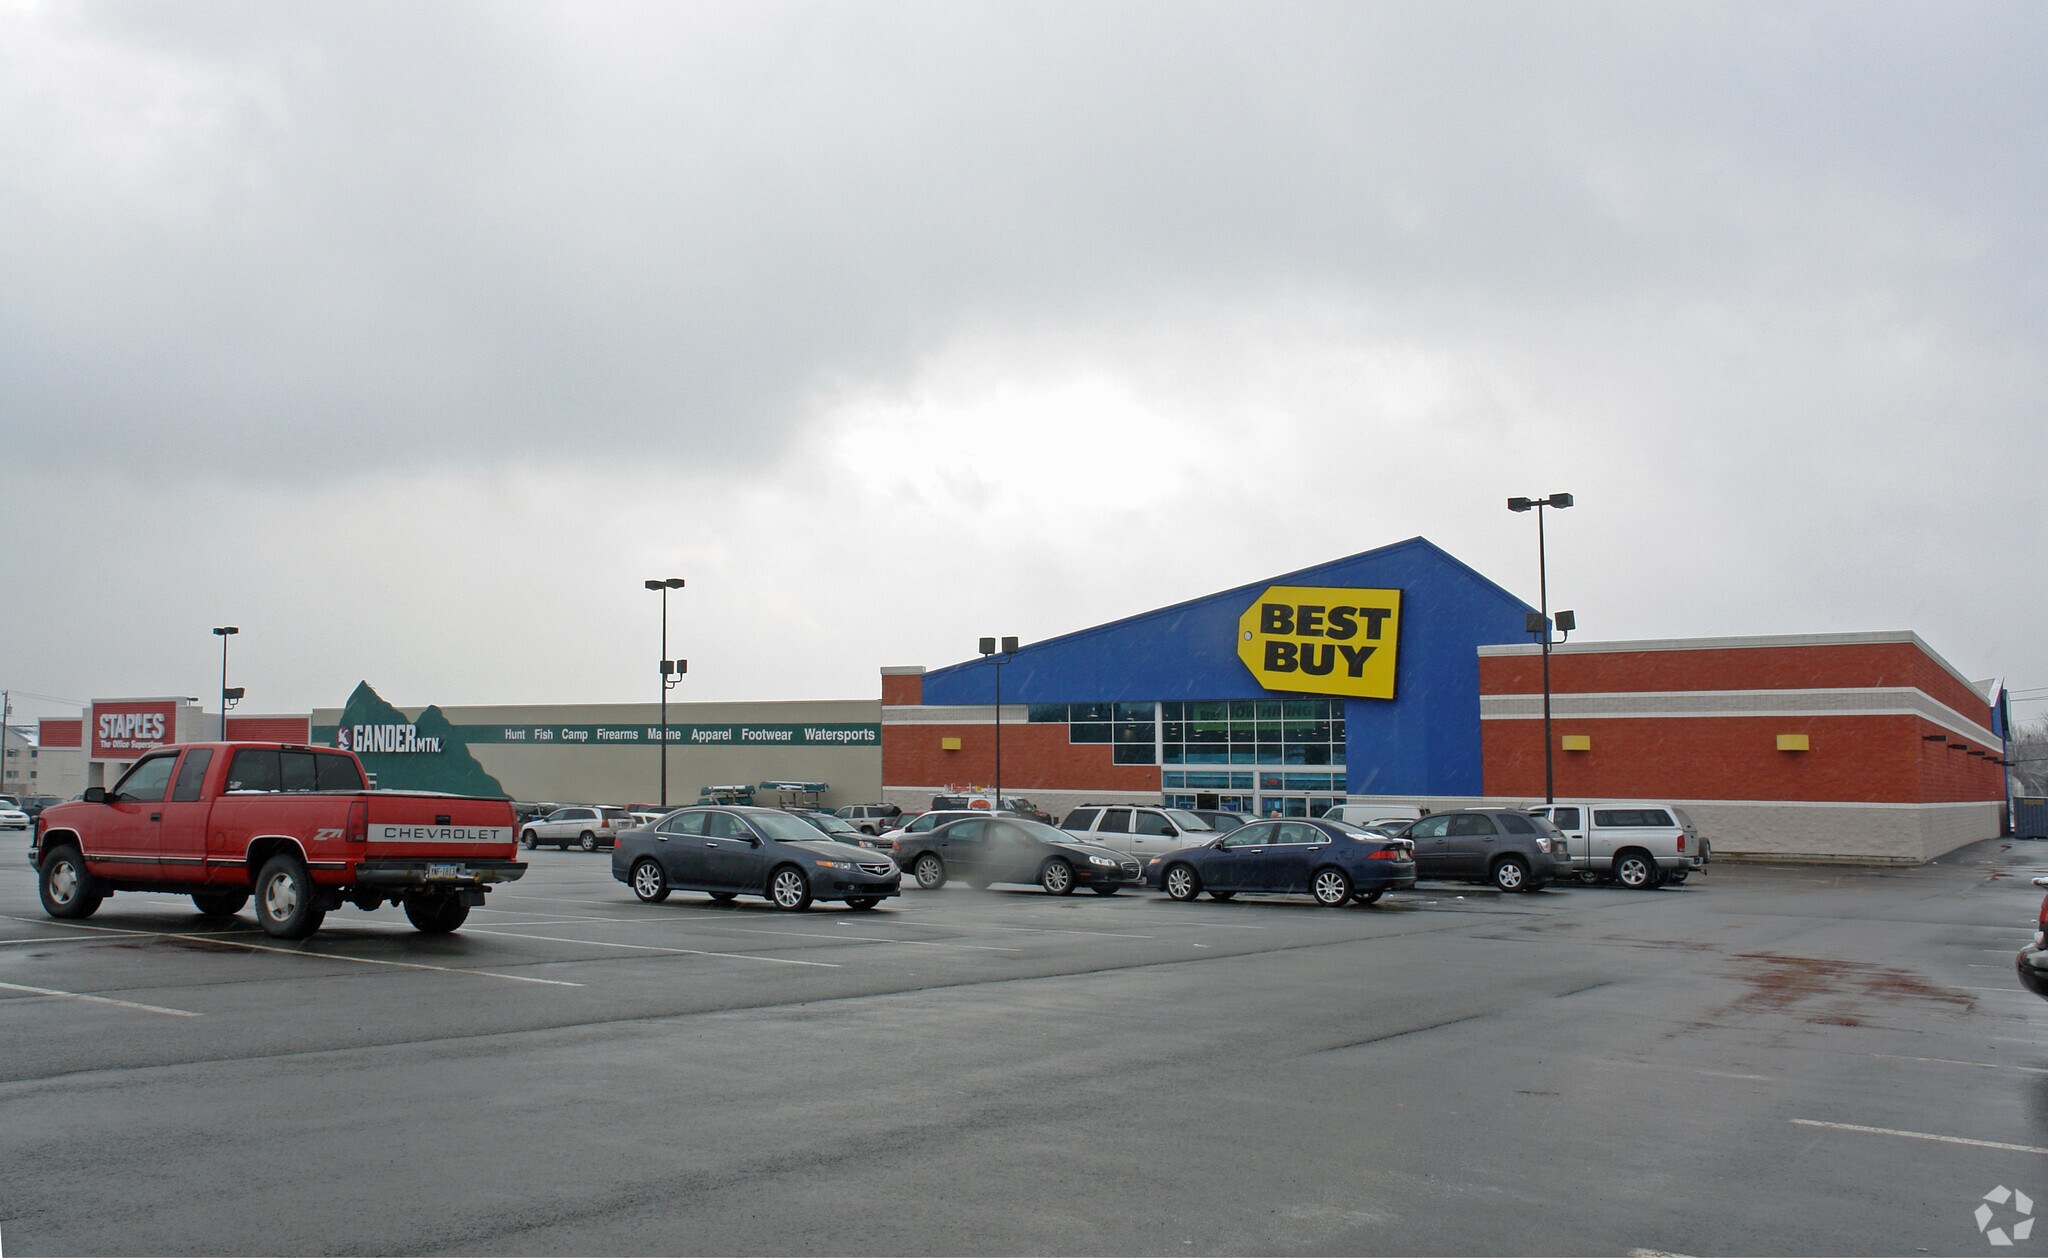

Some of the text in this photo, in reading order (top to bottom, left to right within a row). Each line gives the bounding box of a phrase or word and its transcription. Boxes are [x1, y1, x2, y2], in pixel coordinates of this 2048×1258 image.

[1260, 603, 1391, 640] BEST
[1264, 640, 1378, 678] BUY
[98, 713, 165, 739] STAPLES
[353, 724, 442, 752] GANDER MTN.
[504, 728, 876, 743] Hunt Fish Camp Firearms Maine Apparel Footwear Watersports
[101, 740, 111, 748] The
[112, 740, 130, 748] Office
[384, 827, 500, 840] CHEVROLET
